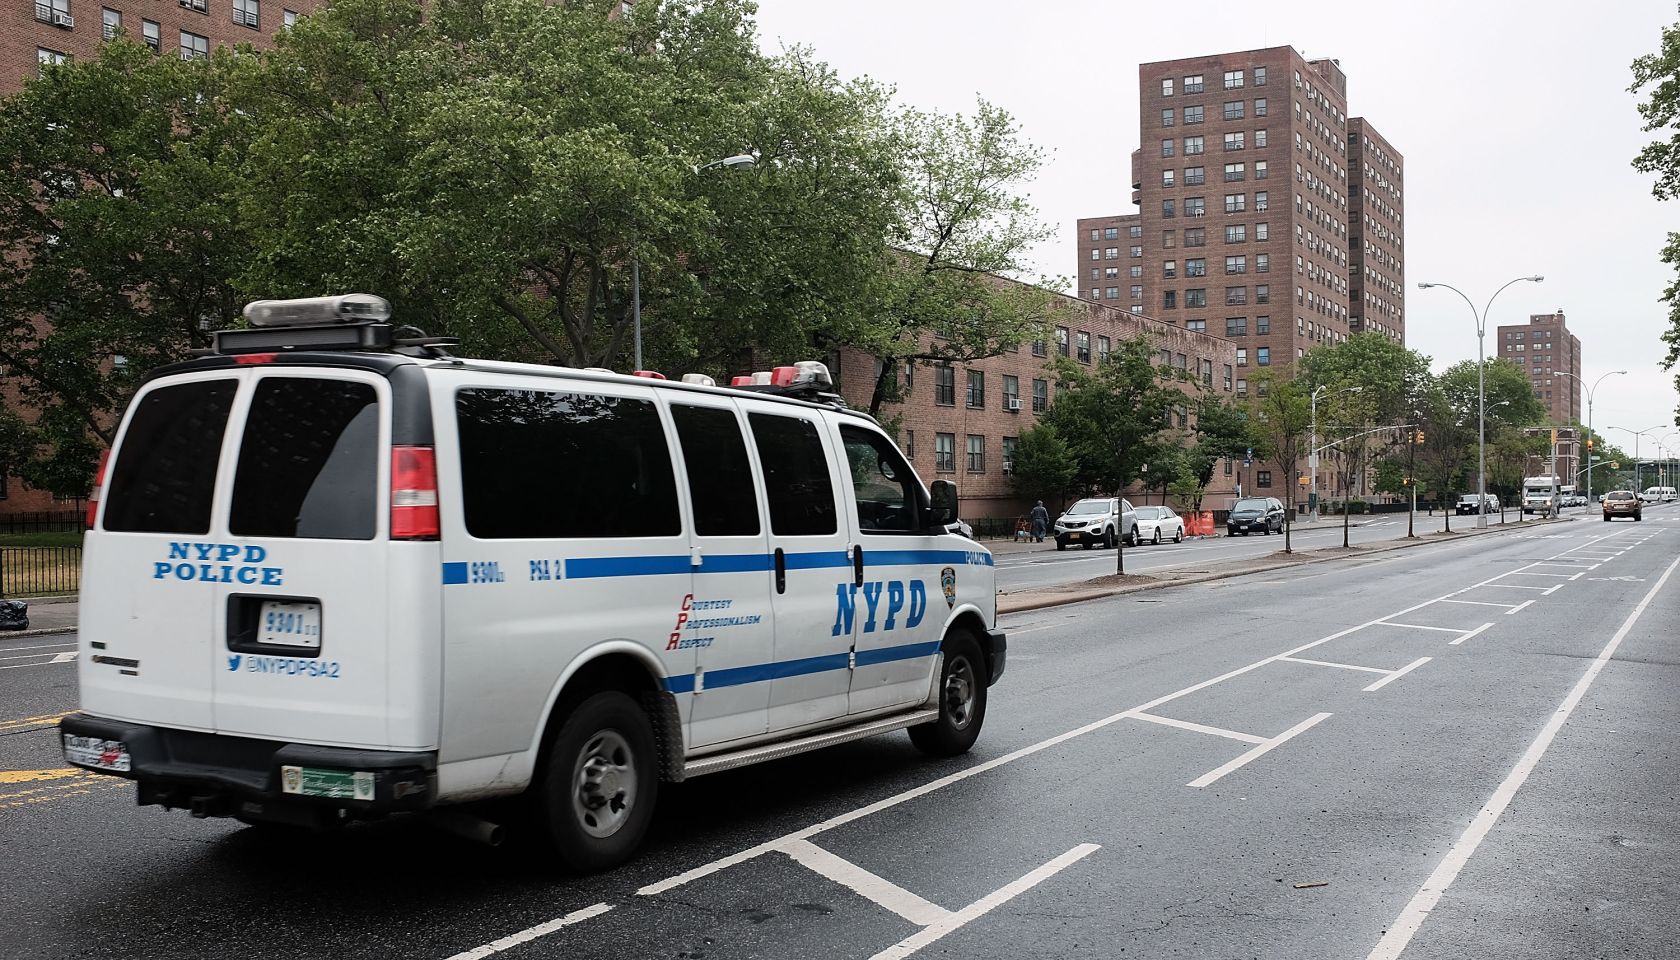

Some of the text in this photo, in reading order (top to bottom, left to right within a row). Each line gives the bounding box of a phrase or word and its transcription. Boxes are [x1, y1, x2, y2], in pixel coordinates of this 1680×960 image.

[168, 542, 267, 564] NYPD
[965, 550, 986, 565] POLICE
[153, 561, 283, 586] POLICE
[529, 559, 551, 581] PSA
[554, 559, 562, 580] 2
[681, 593, 733, 611] COURTESY
[831, 579, 927, 637] NYPD
[674, 612, 762, 631] PROFESSIONALISM
[665, 632, 715, 651] RESPECT
[246, 656, 341, 678] @NYPDPSA2
